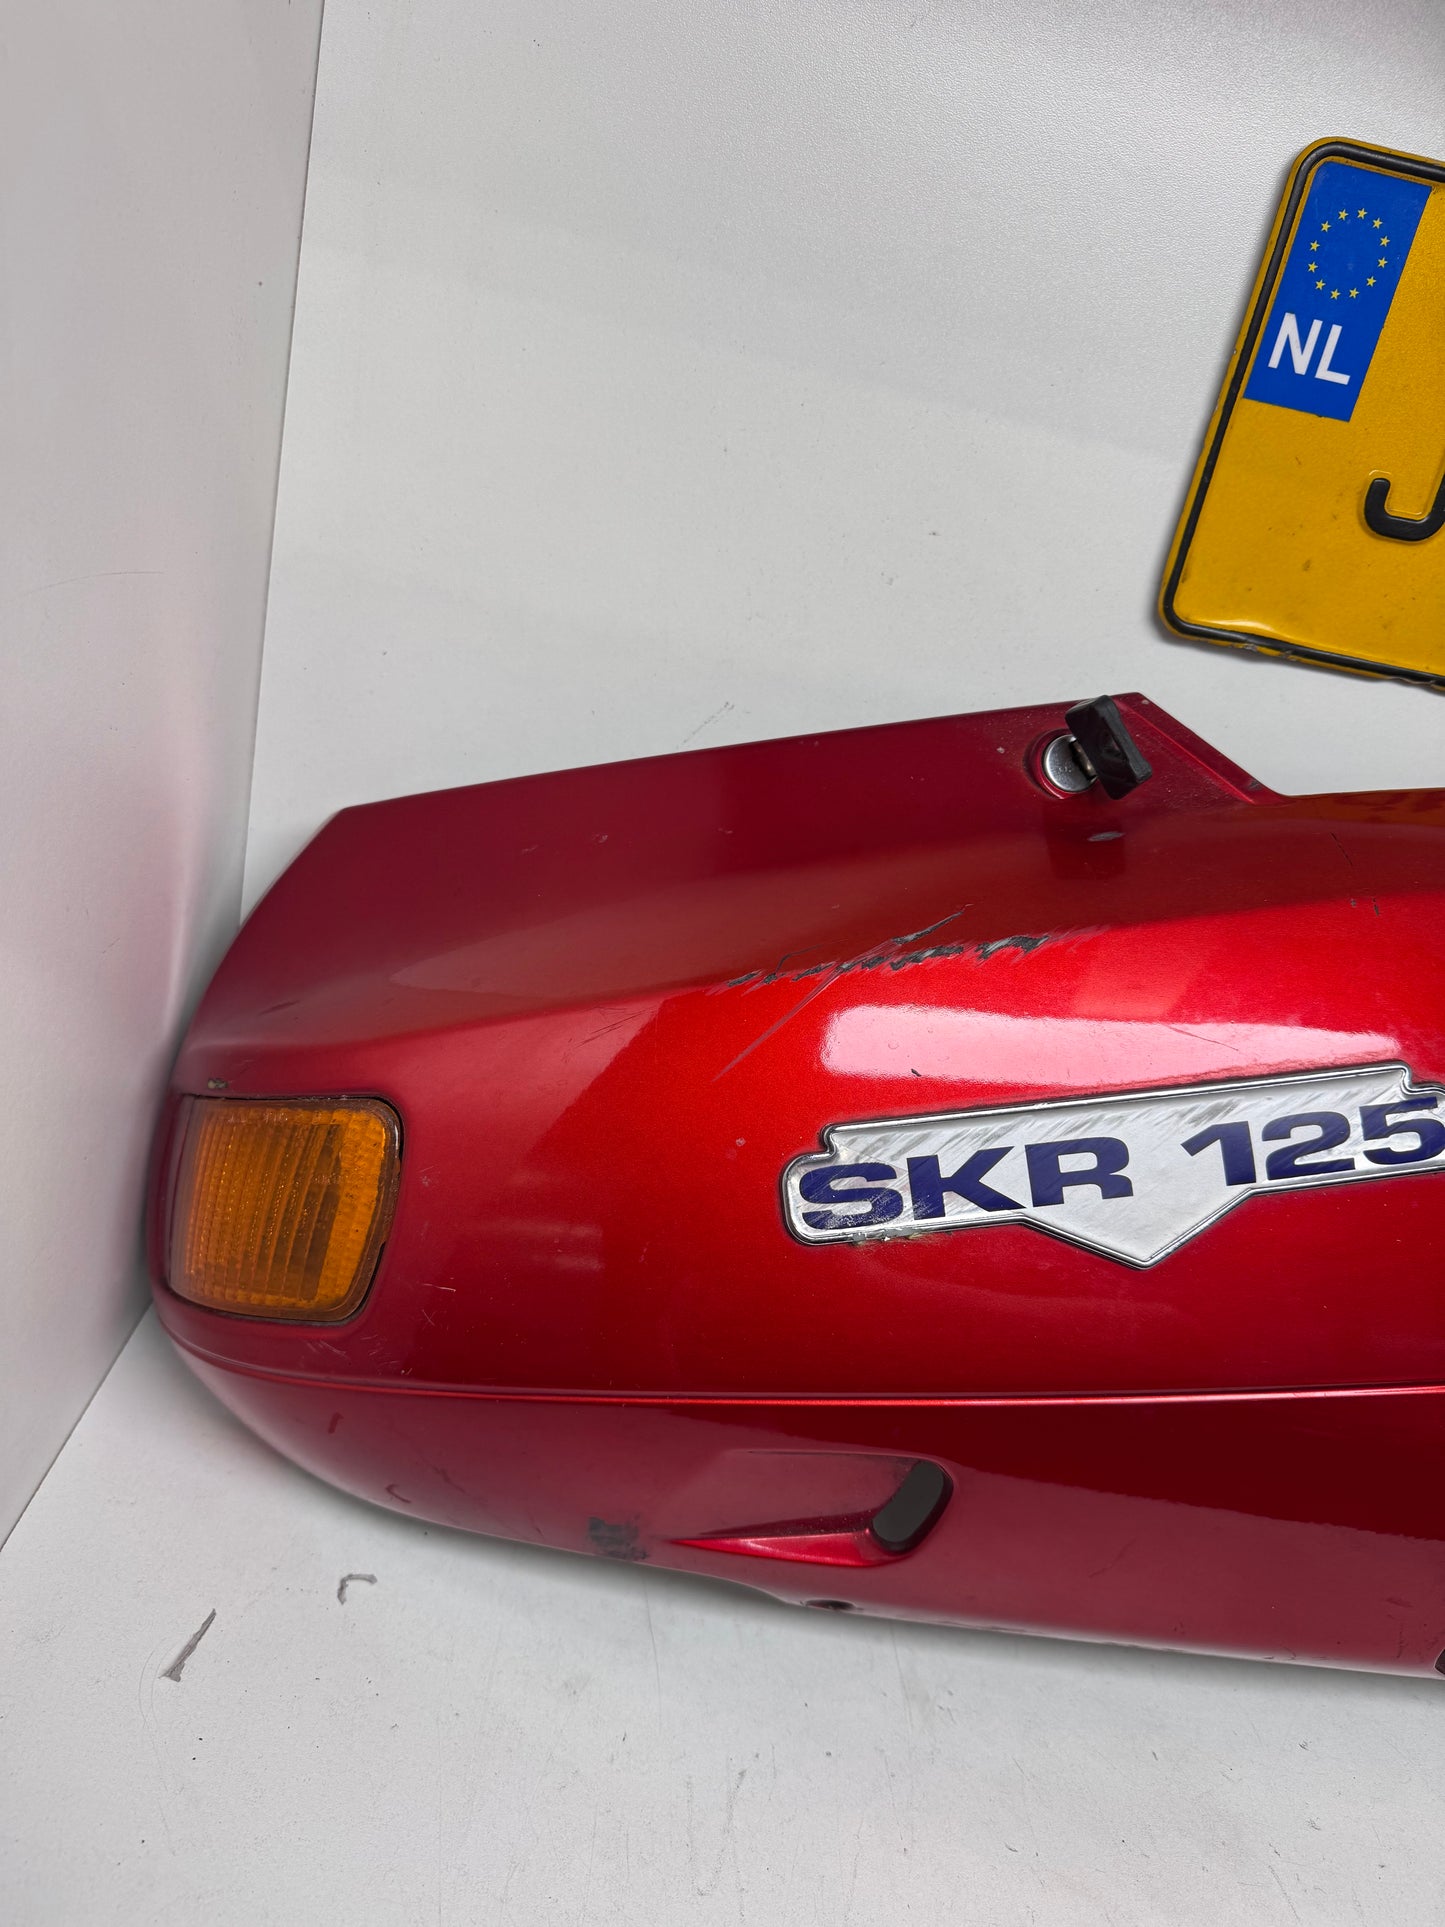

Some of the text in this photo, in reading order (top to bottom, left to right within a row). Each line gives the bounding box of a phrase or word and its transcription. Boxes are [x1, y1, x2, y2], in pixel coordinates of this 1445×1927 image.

[1268, 312, 1351, 386] NL
[800, 1096, 1445, 1230] SKR 125
